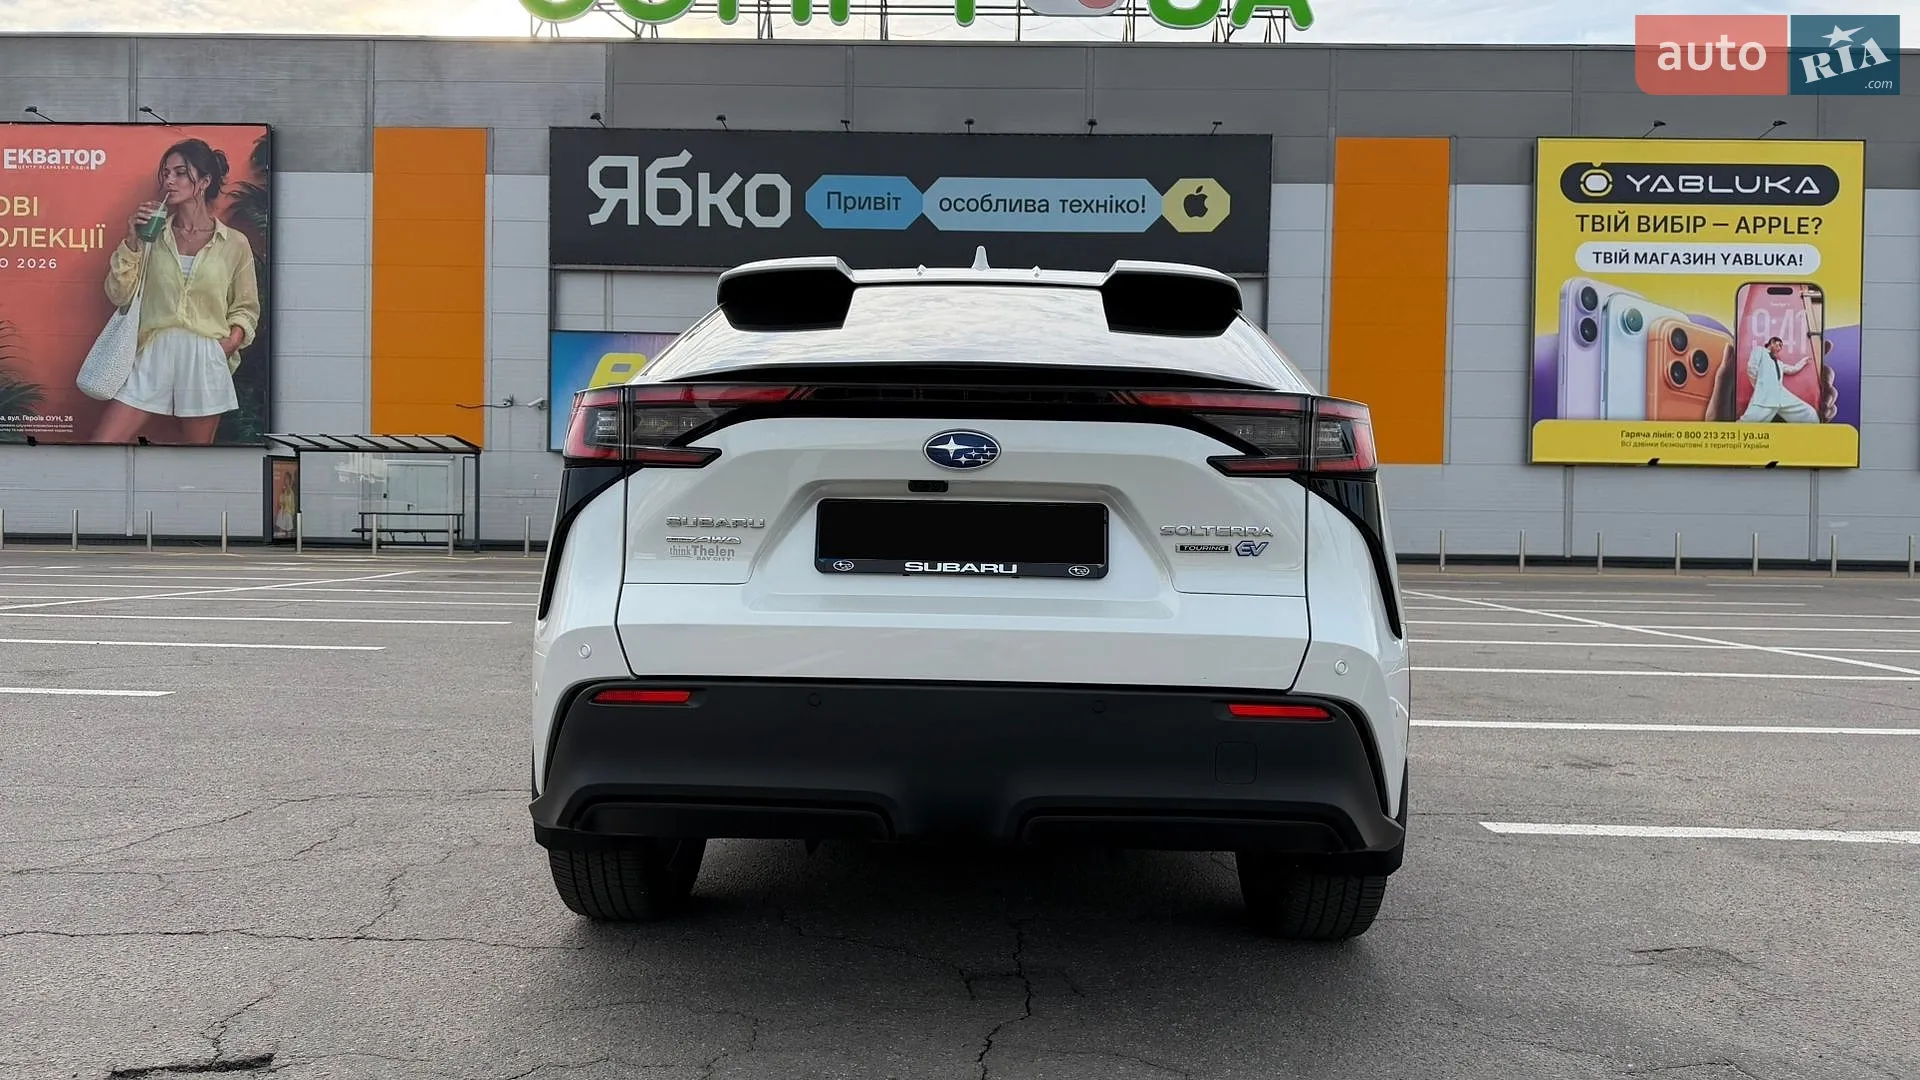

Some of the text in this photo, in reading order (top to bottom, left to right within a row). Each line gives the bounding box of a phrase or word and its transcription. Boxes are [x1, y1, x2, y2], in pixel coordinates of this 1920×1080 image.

[3, 148, 106, 170] Екватор
[588, 148, 792, 229] Ябко
[1626, 174, 1821, 195] YABLUKA
[826, 190, 1146, 214] Привіт особлива техніко!
[1576, 210, 1629, 233] ТВІЙ
[1636, 215, 1707, 234] ВИБІР
[1735, 216, 1823, 235] APPLE?
[17, 258, 57, 269] 2026
[1592, 249, 1804, 267] ТВІЙ МАГАЗИН YABLUKA!
[1620, 430, 1651, 439] Гаряча
[1652, 430, 1675, 439] лінія:
[1676, 431, 1683, 439] 0
[1684, 431, 1702, 439] 800
[1703, 431, 1719, 440] 213
[1720, 431, 1736, 440] 213
[1743, 431, 1770, 442] ya.ua
[666, 516, 766, 529] SUBARU
[1160, 525, 1274, 537] SOLTERRA
[1183, 540, 1270, 557] TOURING EV
[904, 561, 1018, 574] SUBARU
